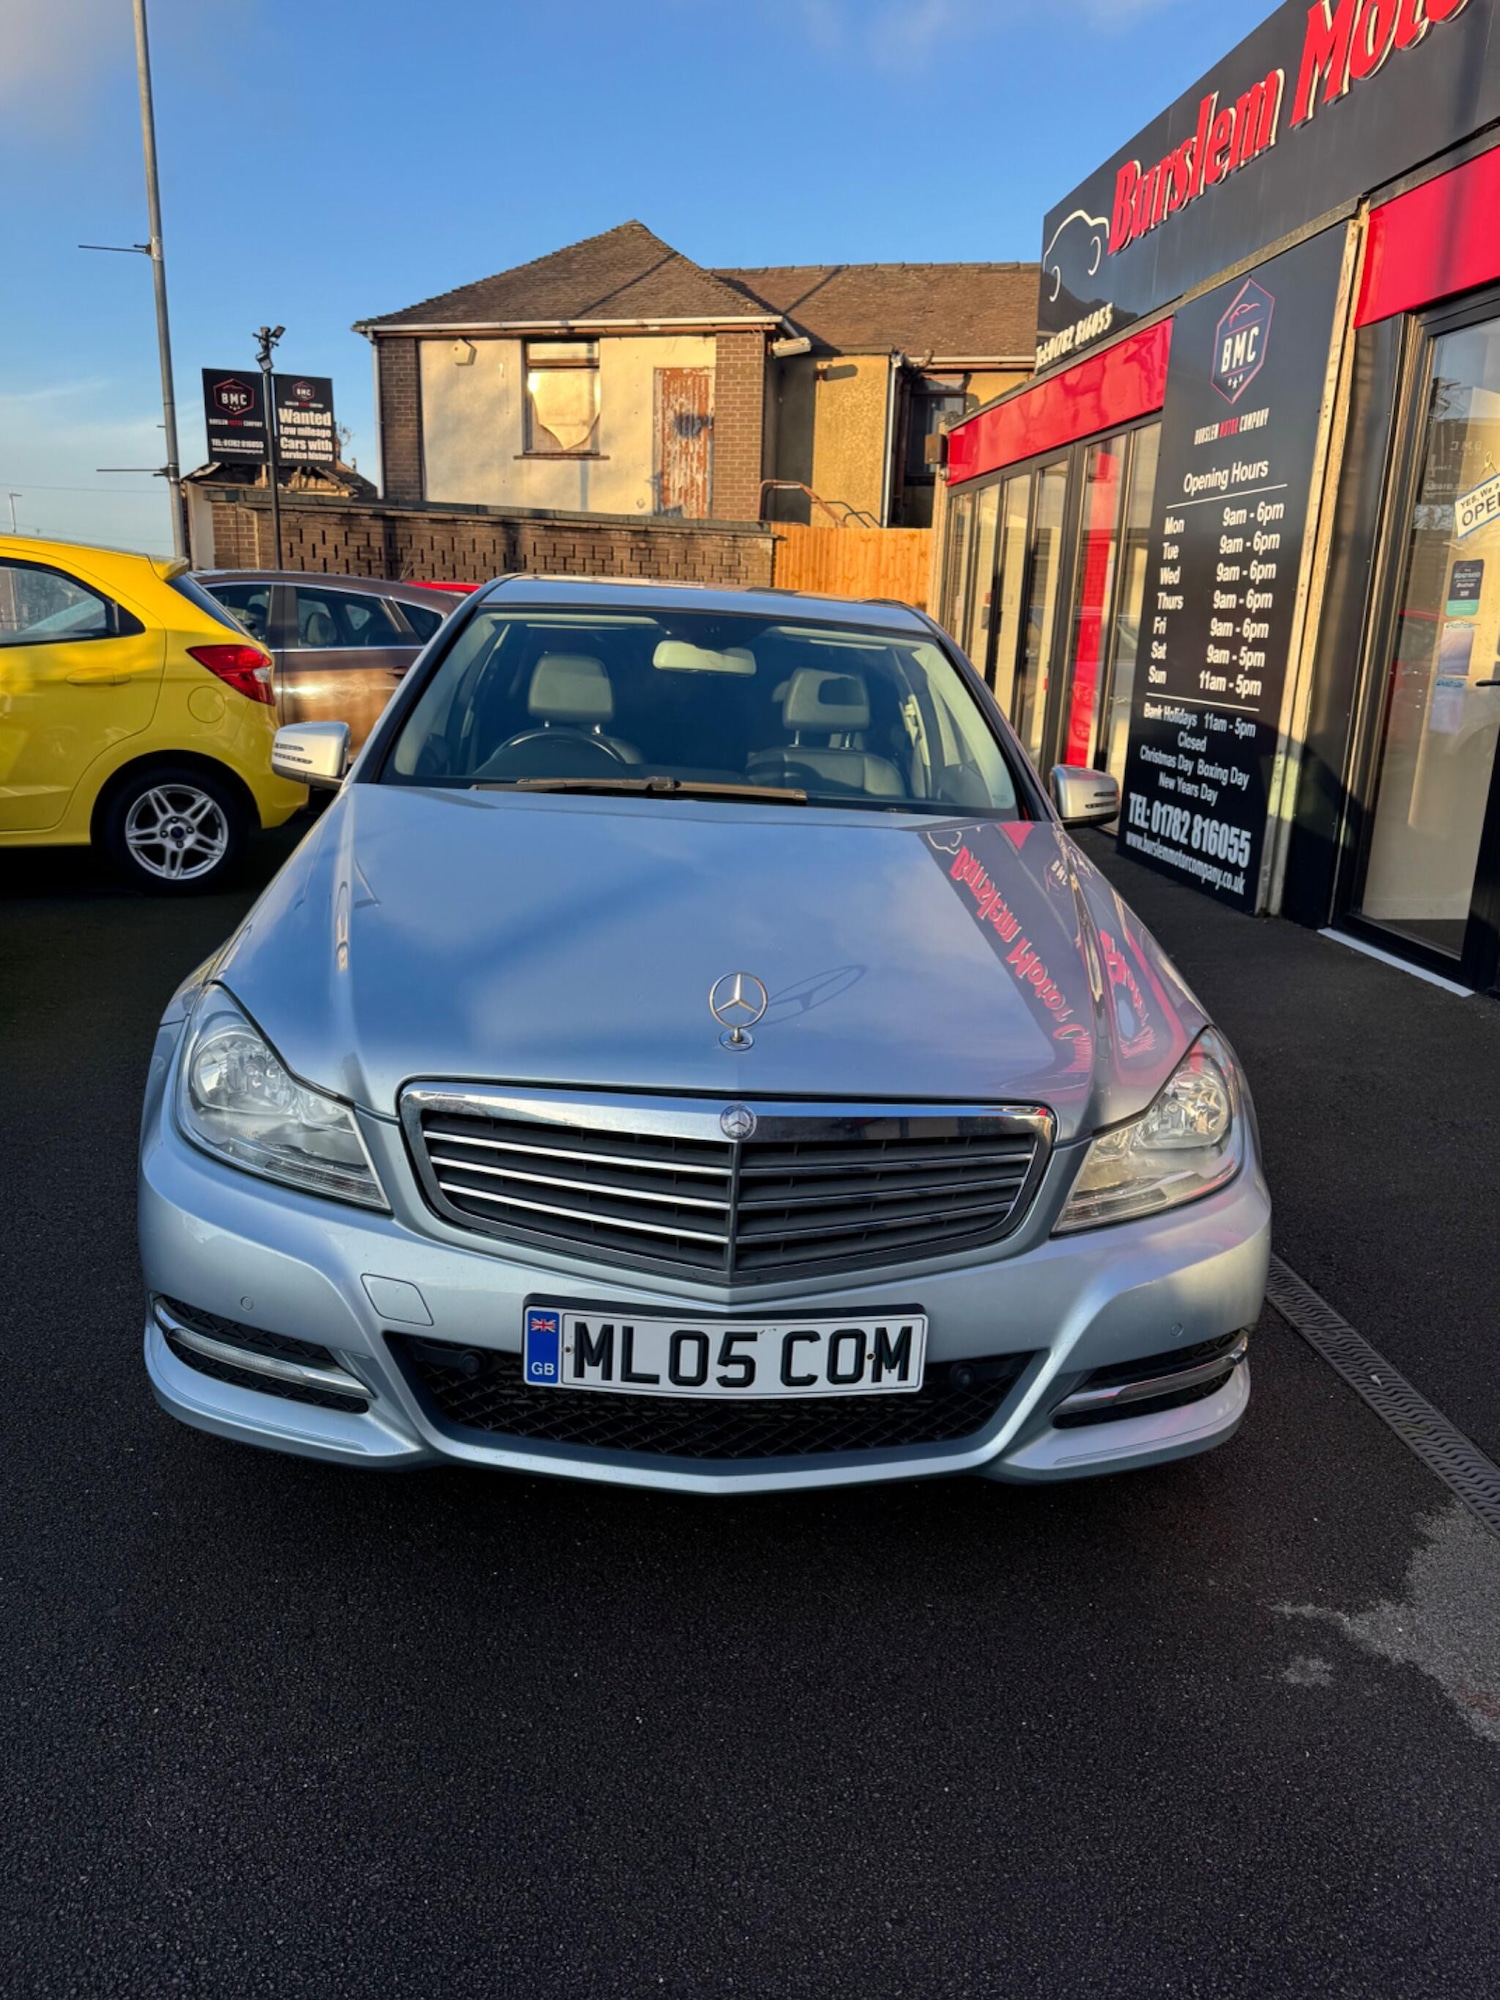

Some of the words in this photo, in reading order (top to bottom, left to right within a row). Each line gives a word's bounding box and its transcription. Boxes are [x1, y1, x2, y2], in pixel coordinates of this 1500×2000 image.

[1108, 69, 1285, 256] Burslem
[1075, 302, 1113, 346] 816055
[1221, 326, 1259, 373] BMC
[221, 392, 247, 405] BMC
[278, 407, 332, 426] Wanted
[280, 425, 296, 436] Low
[297, 426, 331, 439] mileage
[280, 436, 307, 450] Cars
[308, 439, 333, 452] with
[1183, 467, 1228, 496] Opening
[1231, 459, 1269, 484] Hours
[1164, 516, 1185, 535] Mon
[1222, 507, 1246, 526] 9am
[1256, 501, 1285, 526] 6pm
[1462, 491, 1500, 526] OPE
[1162, 542, 1179, 560] Tue
[1219, 535, 1243, 554] 9am
[1253, 531, 1280, 556] 6pm
[1160, 566, 1181, 585] Wed
[1216, 563, 1240, 582] 9am
[1249, 560, 1277, 585] 6pm
[1157, 592, 1184, 610] Thurs
[1213, 590, 1236, 609] 9am
[1245, 588, 1273, 613] 6pm
[1153, 616, 1167, 635] Fri
[1210, 617, 1233, 637] 9am
[1242, 617, 1269, 642] 6pm
[1151, 641, 1167, 660] Sat
[1206, 644, 1230, 664] 9am
[1239, 646, 1265, 671] 5pm
[1148, 665, 1167, 684] Sun
[1199, 670, 1226, 692] 11am
[1235, 674, 1262, 699] 5pm
[1143, 702, 1162, 720] Bank
[1163, 706, 1198, 730] Holidays
[1204, 712, 1227, 731] 11am
[1234, 718, 1256, 739] 5pm
[1178, 730, 1207, 752] Closed
[1140, 745, 1176, 767] Christmas
[1177, 753, 1194, 776] Day
[1197, 758, 1229, 786] Boxing
[1230, 765, 1250, 790] Day
[1158, 771, 1175, 791] New
[1177, 776, 1199, 797] Years
[1200, 783, 1218, 806] Day
[1151, 800, 1191, 845] 01782
[1191, 813, 1252, 868] 816055
[1126, 830, 1245, 895] www.burslemmotorcompany.co.uk
[531, 1361, 555, 1376] GB
[573, 1322, 758, 1388] ML05
[780, 1326, 913, 1388] COM
